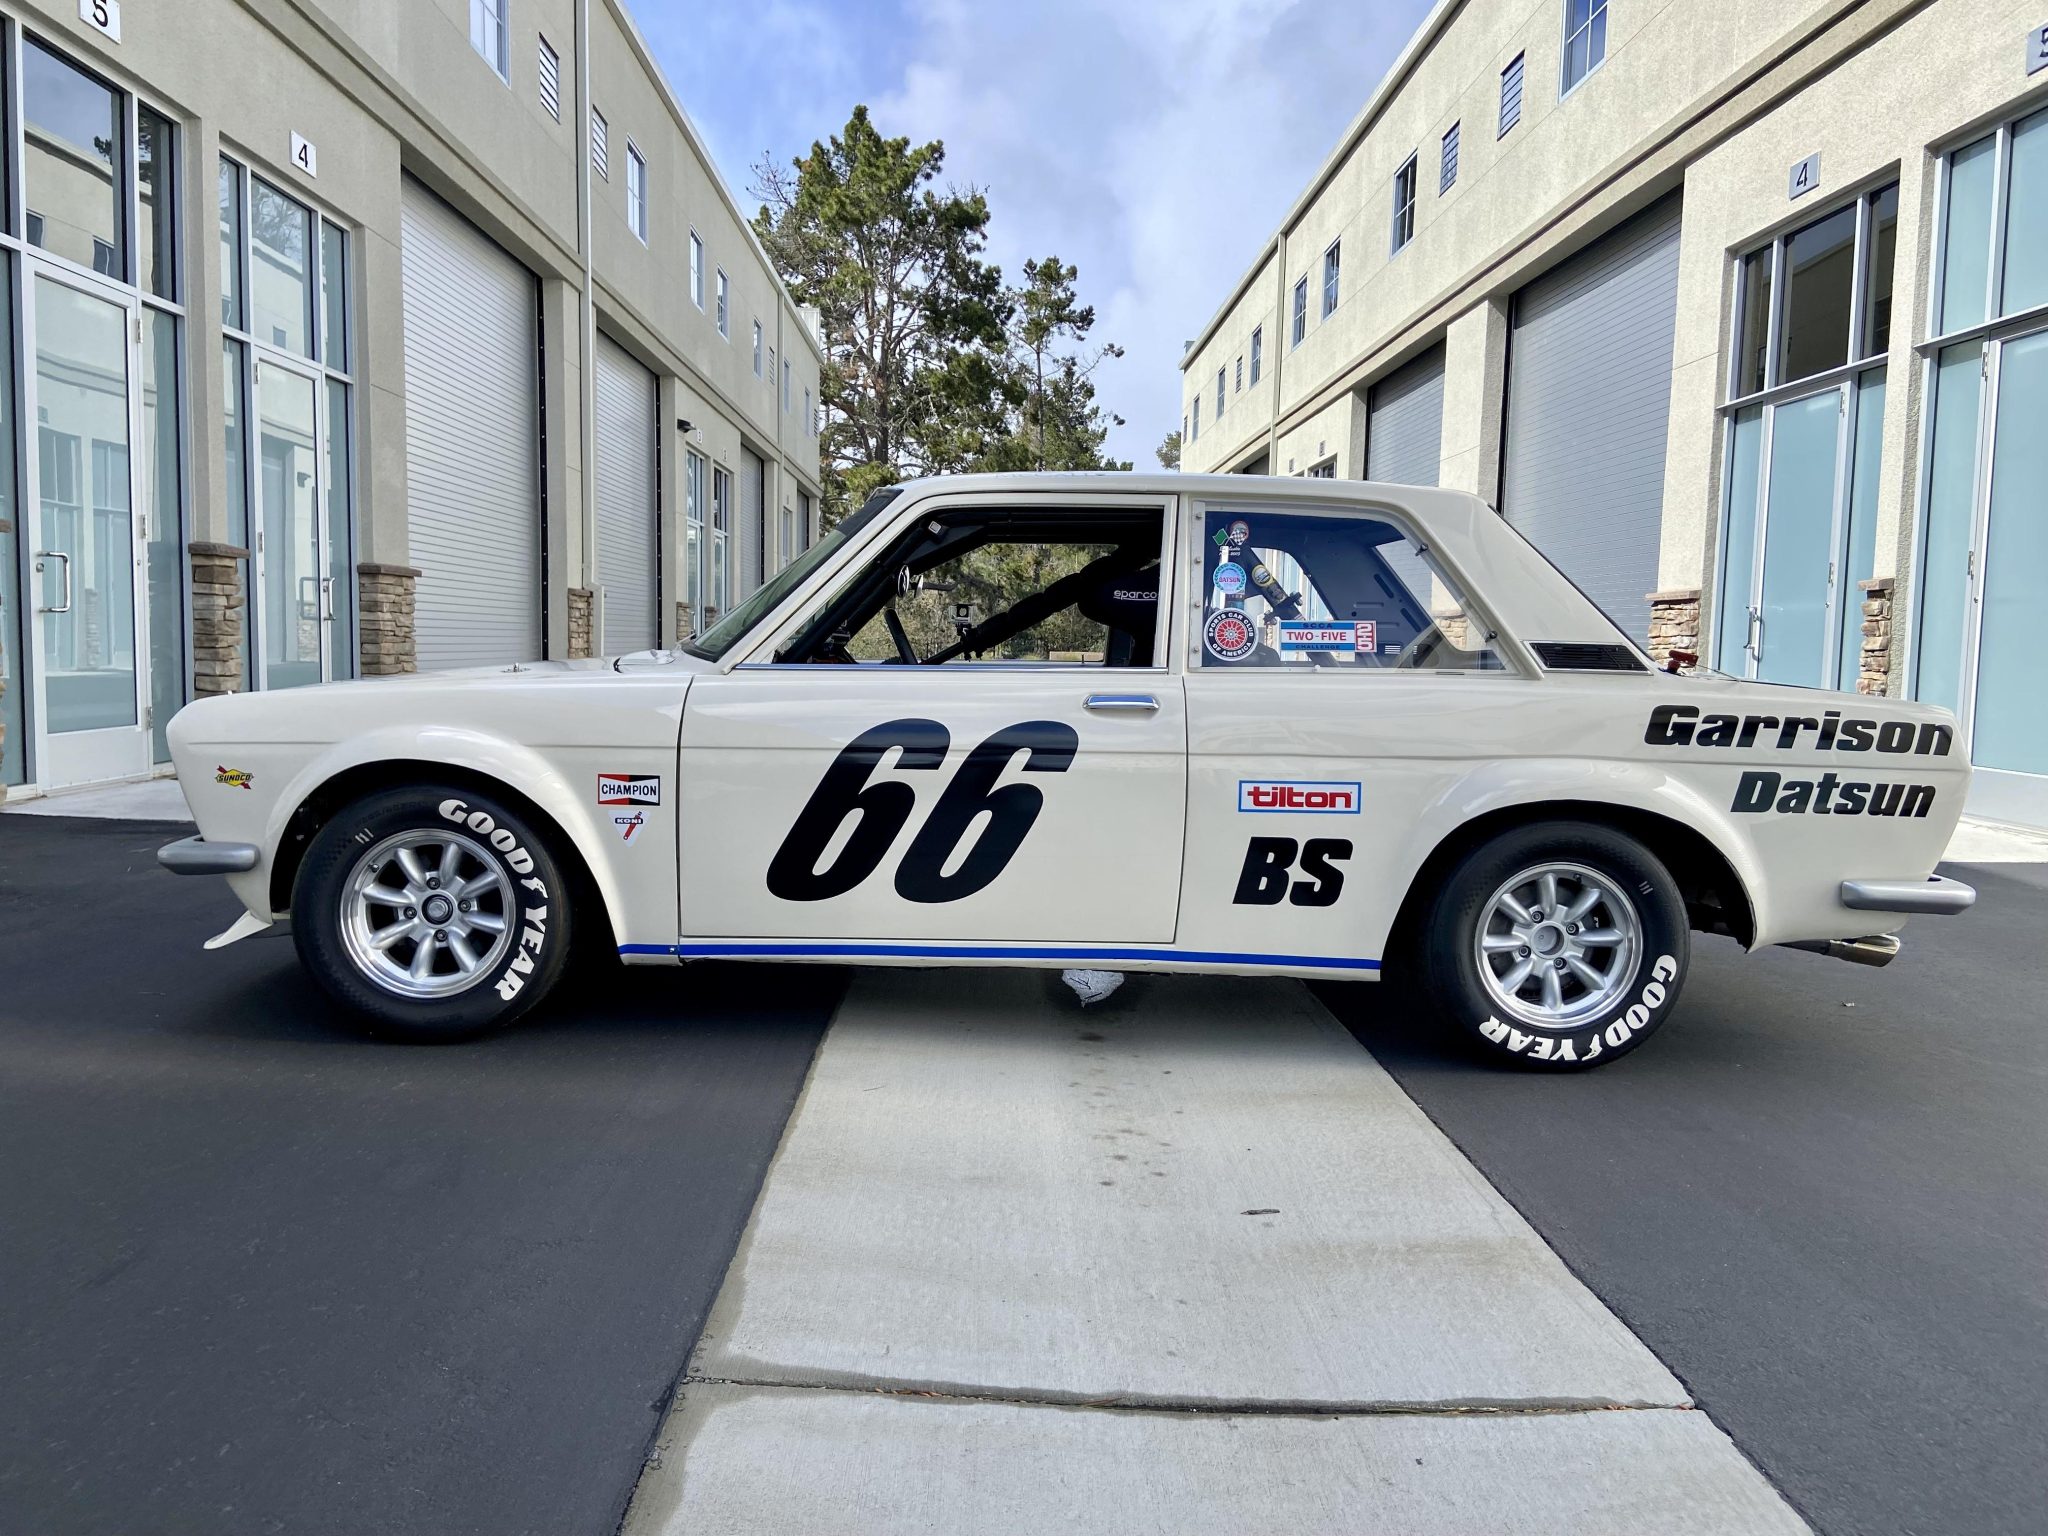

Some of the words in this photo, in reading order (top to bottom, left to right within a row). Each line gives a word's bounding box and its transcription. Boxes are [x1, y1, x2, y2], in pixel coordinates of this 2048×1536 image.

[298, 143, 308, 168] 4
[1796, 161, 1808, 187] 4
[1113, 590, 1157, 600] sparco
[1209, 614, 1226, 637] SPORTS
[1228, 612, 1243, 620] CAR
[1243, 620, 1254, 637] CLUB
[1212, 643, 1222, 651] OF
[1222, 642, 1252, 657] AMERICA
[1643, 704, 1954, 756] Garrison
[218, 774, 251, 782] SUNOCO
[601, 783, 657, 796] CHAMPION
[1247, 786, 1352, 808] tilton
[1730, 771, 1937, 818] Datsun
[766, 717, 1079, 904] 66
[1232, 836, 1354, 907] BS
